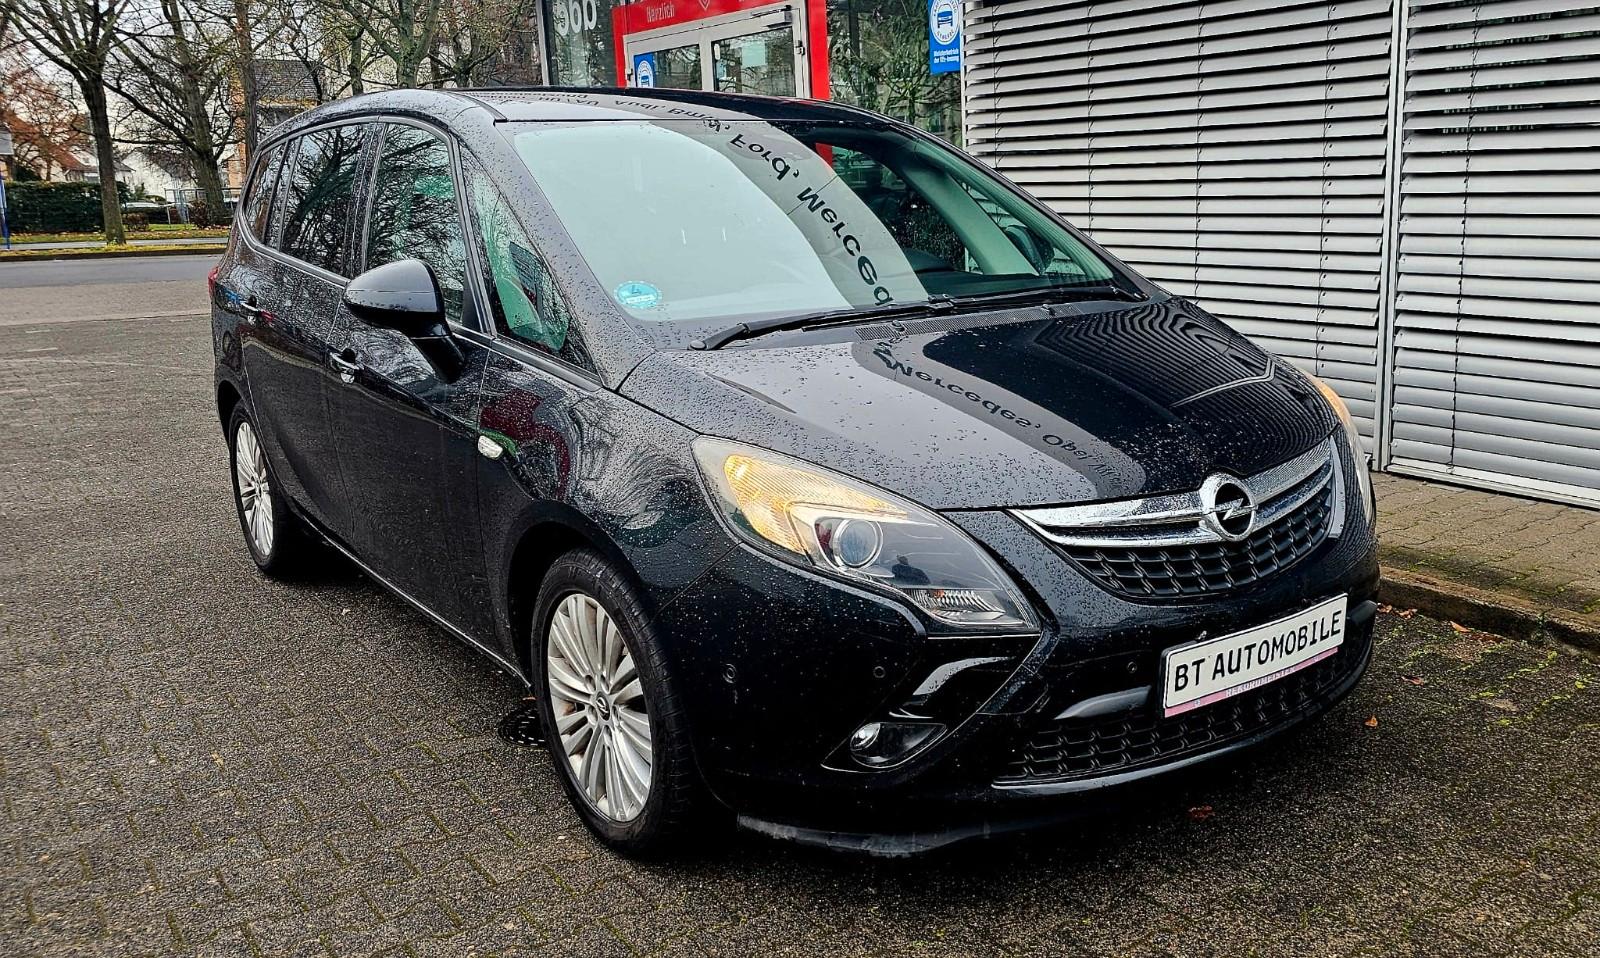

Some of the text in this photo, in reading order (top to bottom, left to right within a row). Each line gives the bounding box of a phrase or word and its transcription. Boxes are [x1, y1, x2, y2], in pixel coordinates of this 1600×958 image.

[646, 1, 675, 23] Herzlich
[1174, 610, 1342, 692] BT AUTOMOBILE
